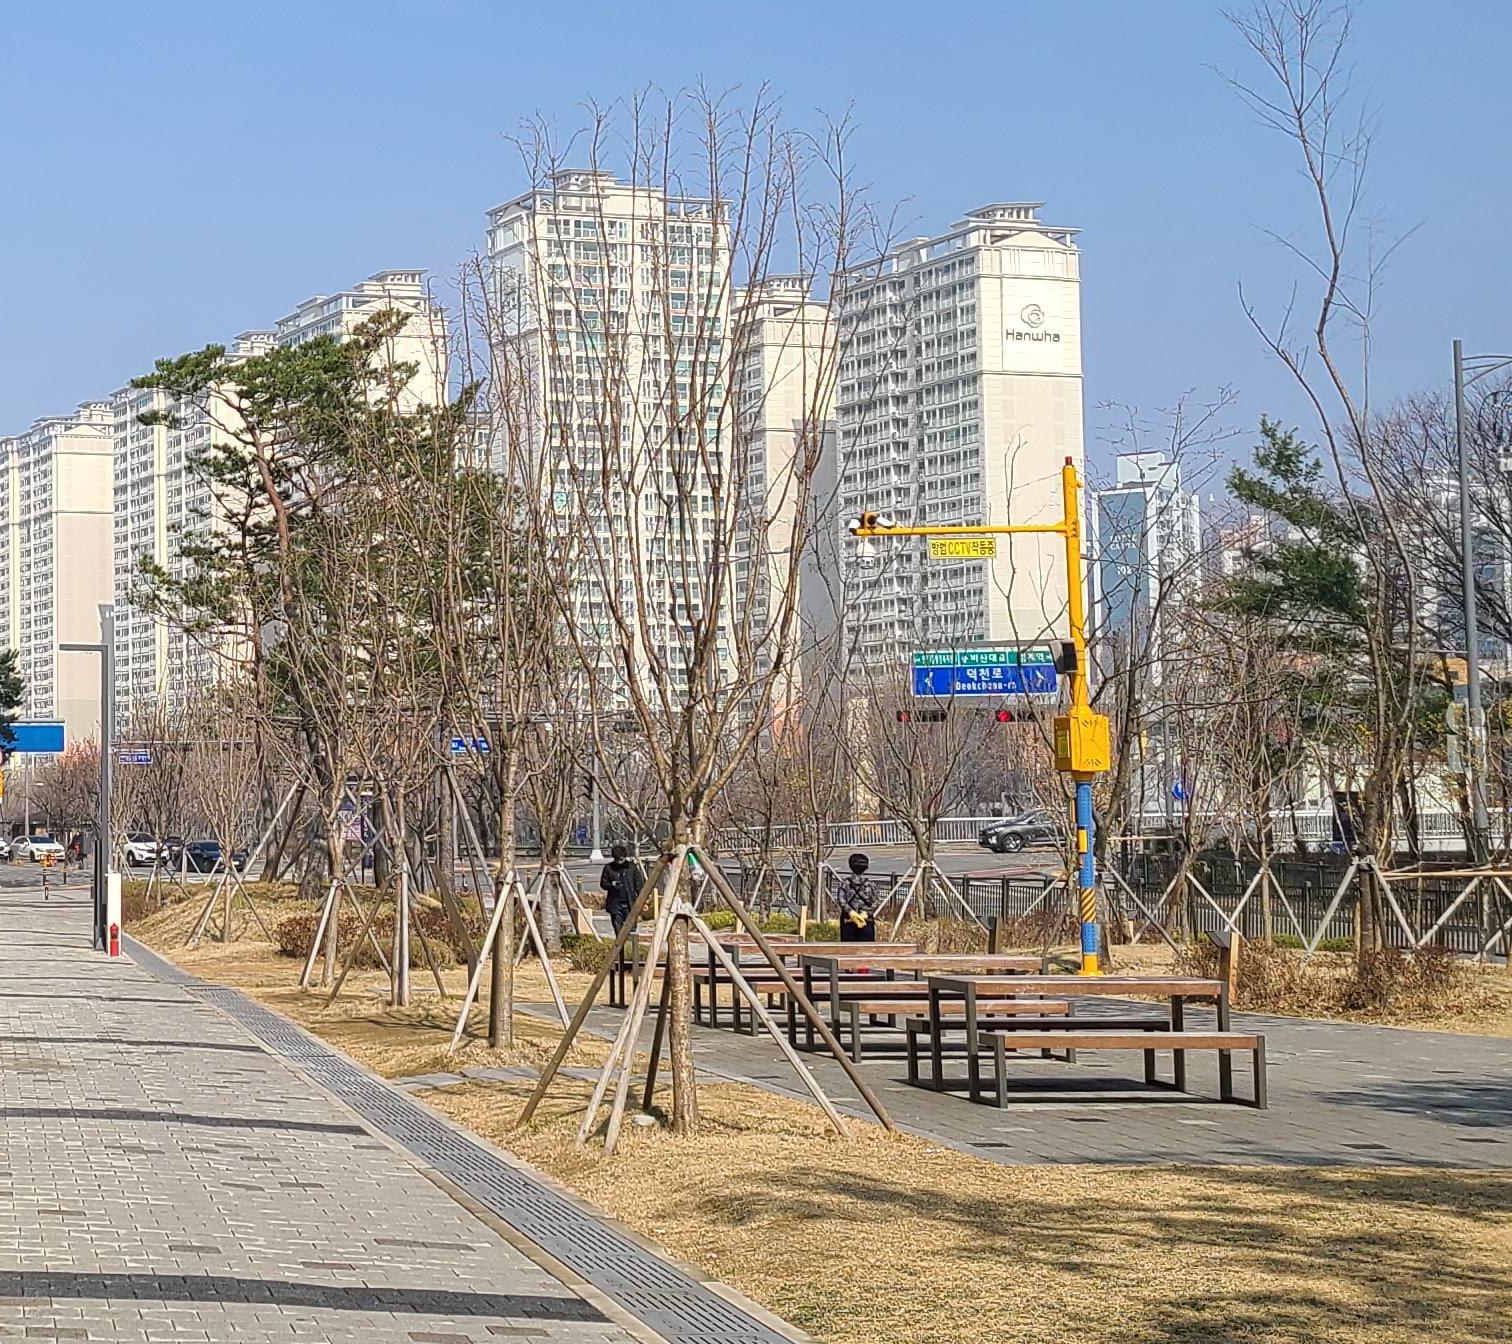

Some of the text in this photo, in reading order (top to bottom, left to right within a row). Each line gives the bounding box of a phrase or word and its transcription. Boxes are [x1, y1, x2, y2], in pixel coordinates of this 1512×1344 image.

[1006, 329, 1060, 343] Hanwha
[948, 541, 970, 555] CCTV
[966, 667, 1003, 681] 덕천로
